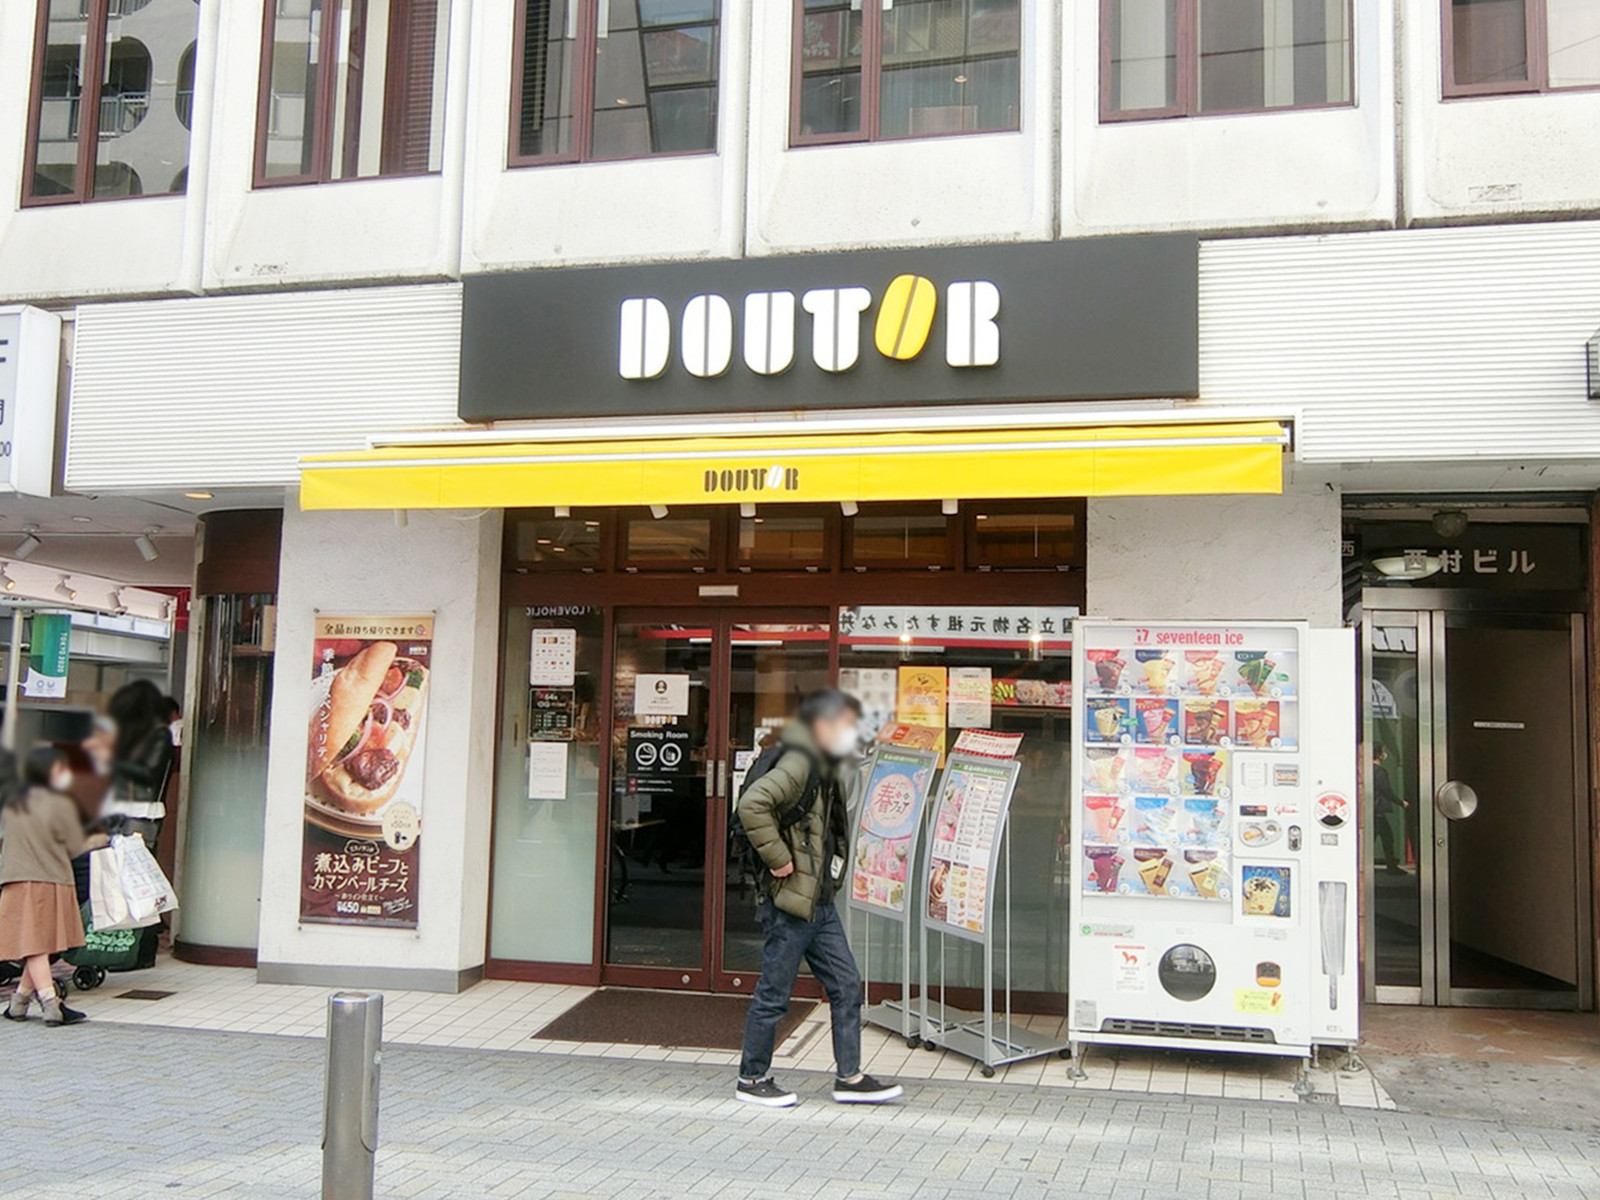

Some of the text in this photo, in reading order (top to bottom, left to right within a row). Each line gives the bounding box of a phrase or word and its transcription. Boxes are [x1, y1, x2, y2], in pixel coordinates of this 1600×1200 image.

[619, 274, 1001, 379] DOUTOR
[704, 465, 799, 492] DOUTOR
[1404, 549, 1536, 574] 西村ビル
[324, 623, 414, 635] 全品お持ち帰りできます
[1156, 630, 1220, 645] seventeen
[1225, 629, 1244, 645] ice
[59, 632, 68, 656] TOKYO
[630, 730, 689, 740] Smoking Room
[314, 853, 409, 875] 煮込みビーフと
[313, 874, 409, 893] カマンベールチーズ
